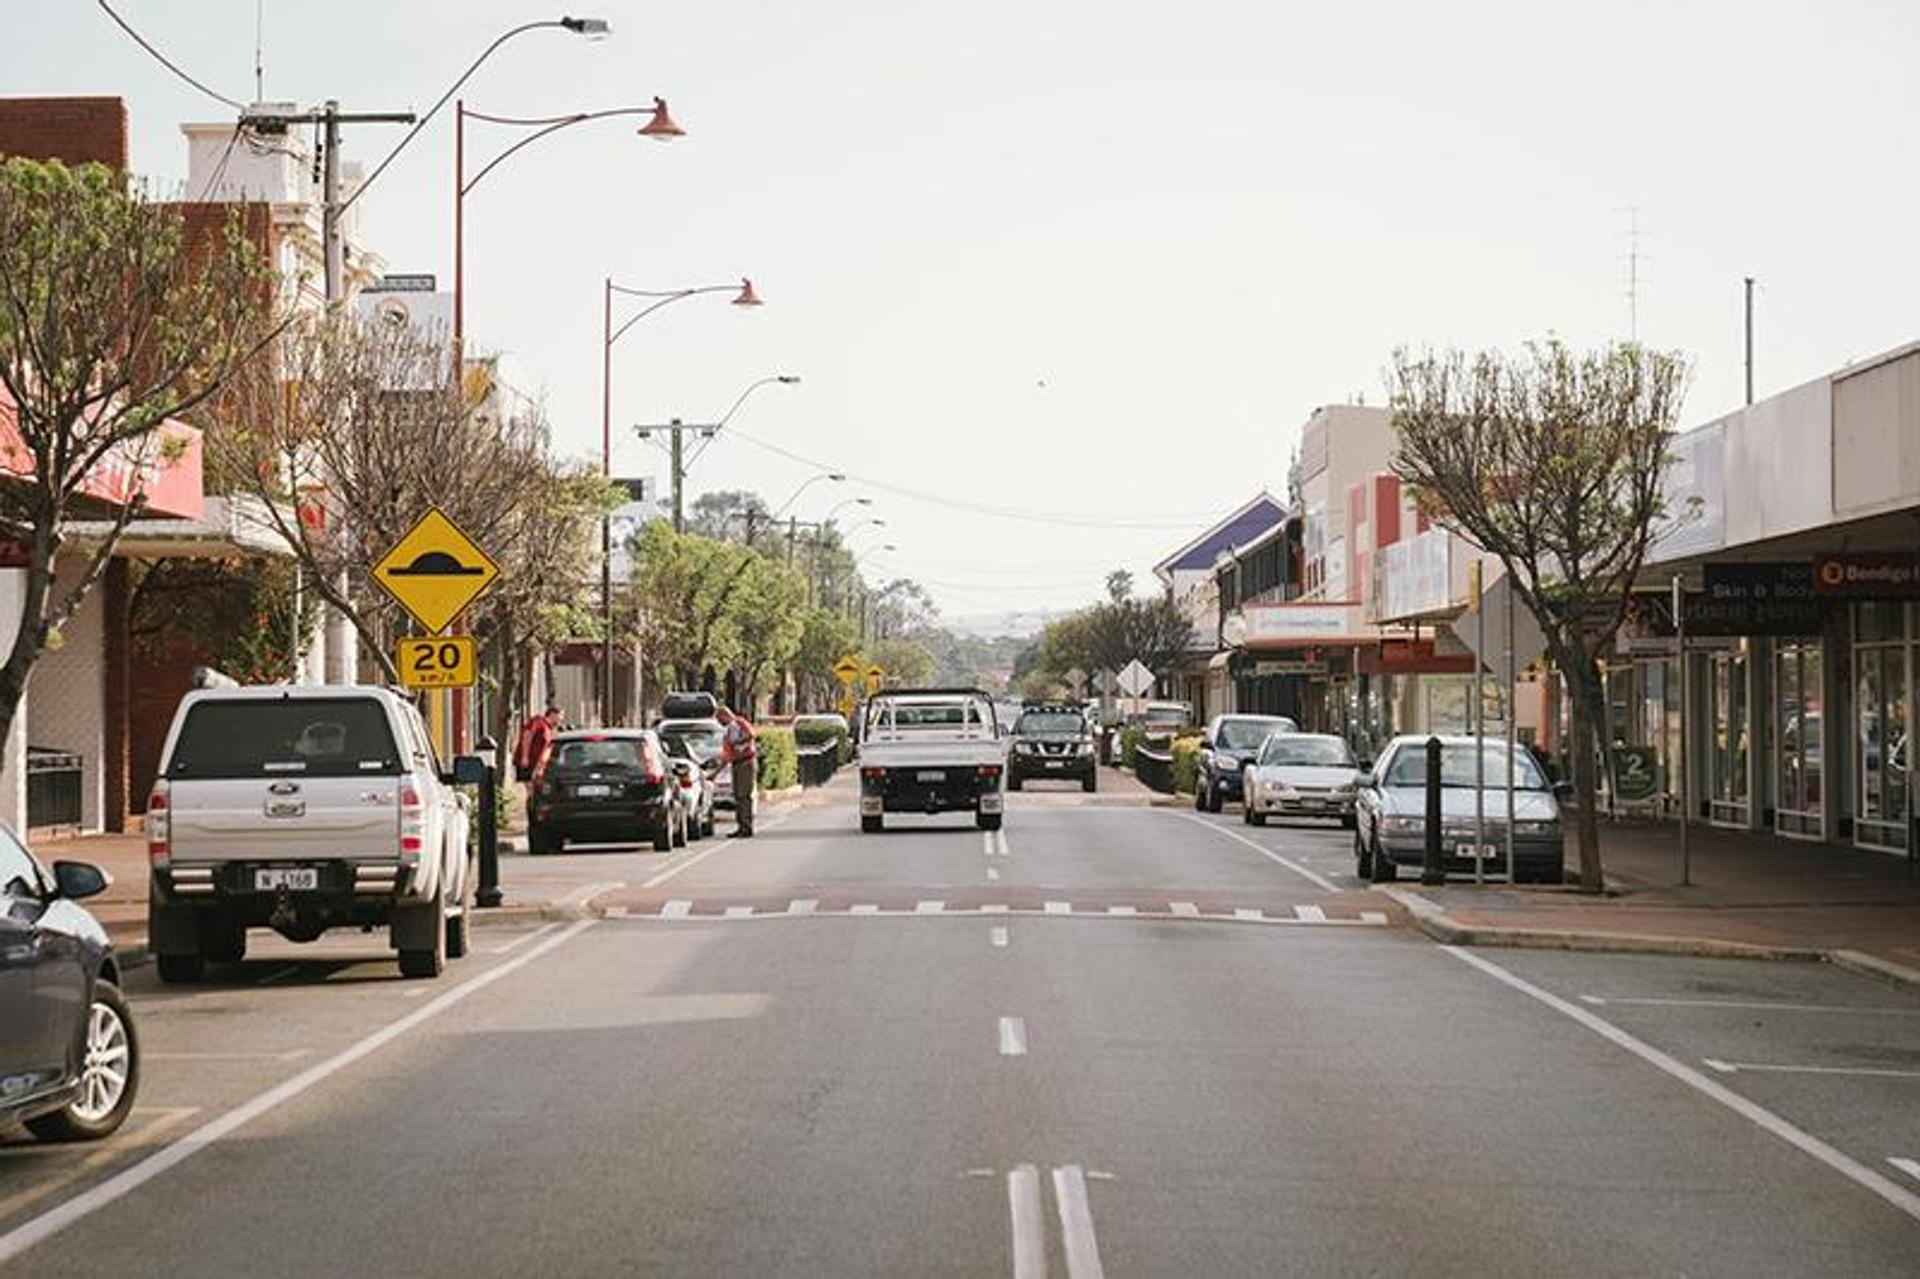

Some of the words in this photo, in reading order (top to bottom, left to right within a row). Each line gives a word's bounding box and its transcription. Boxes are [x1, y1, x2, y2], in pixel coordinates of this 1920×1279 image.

[1847, 564, 1910, 584] Bendigo
[1713, 582, 1748, 598] Skin
[414, 643, 460, 671] 20
